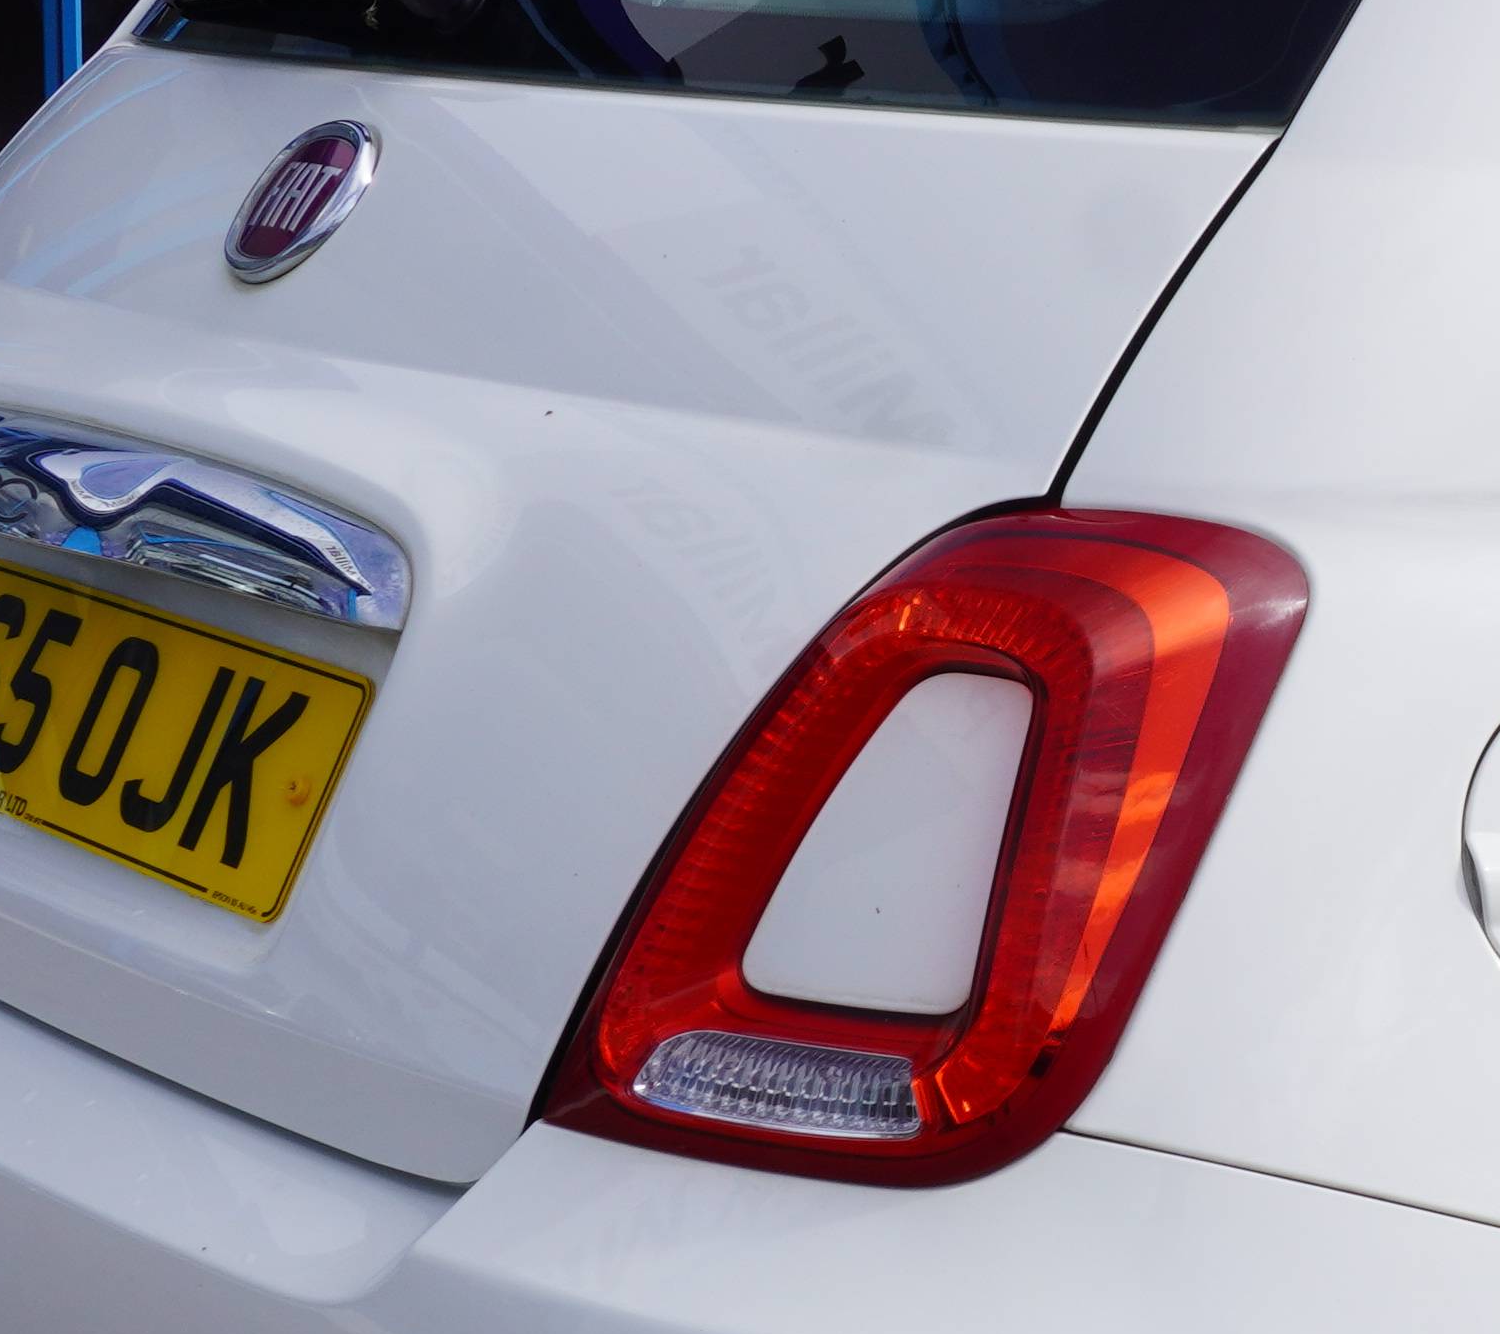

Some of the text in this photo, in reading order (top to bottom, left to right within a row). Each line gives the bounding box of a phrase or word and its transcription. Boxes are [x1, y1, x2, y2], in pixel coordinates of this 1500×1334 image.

[246, 161, 343, 232] FIAT
[58, 636, 310, 869] OJK
[5, 793, 28, 817] LTD
